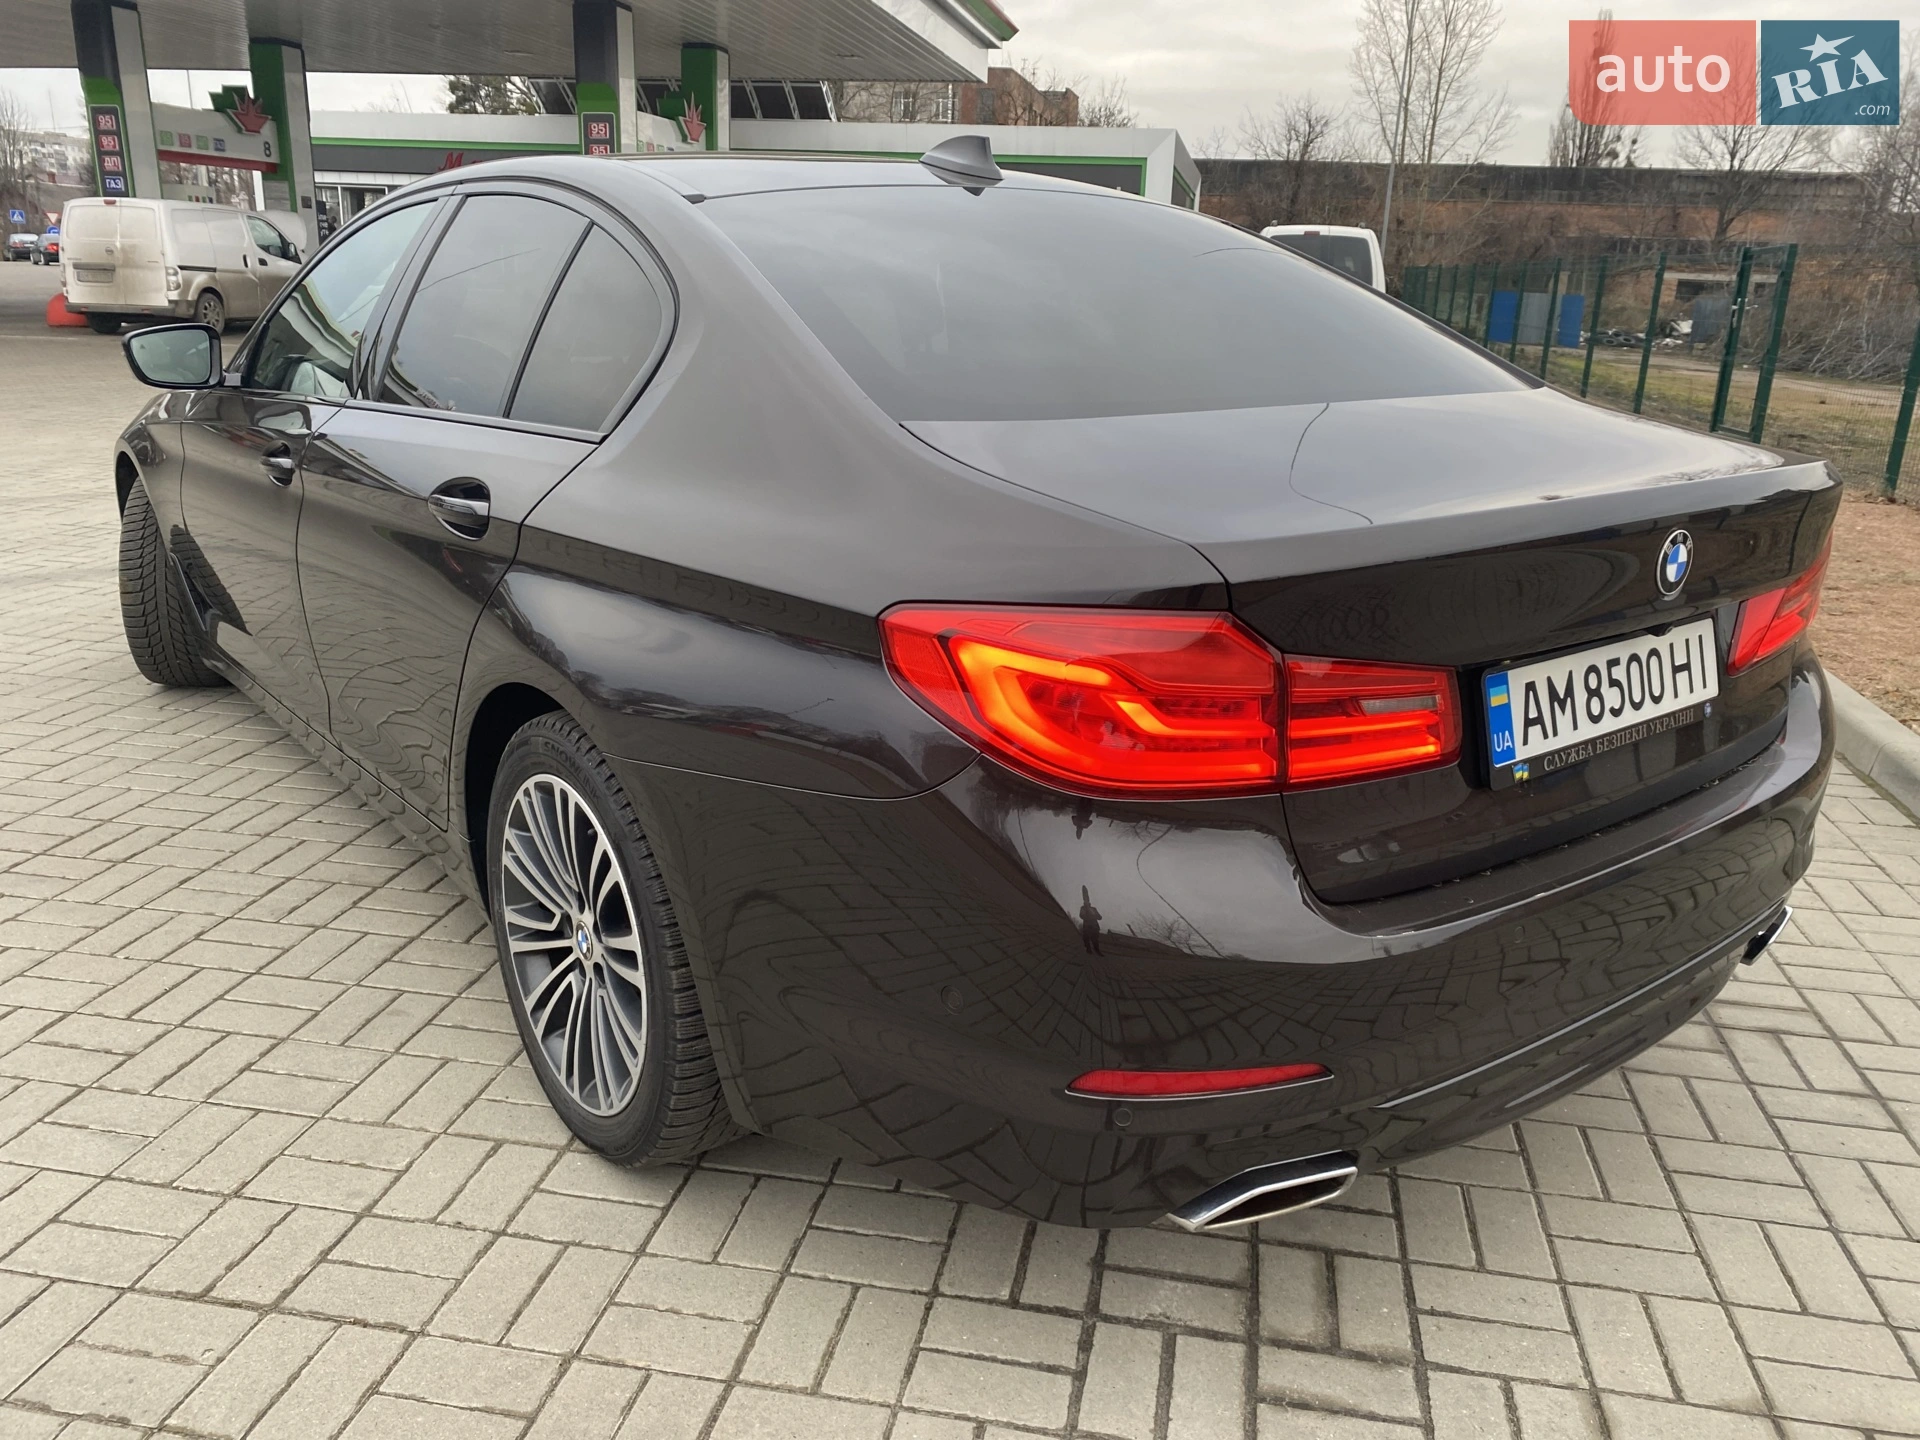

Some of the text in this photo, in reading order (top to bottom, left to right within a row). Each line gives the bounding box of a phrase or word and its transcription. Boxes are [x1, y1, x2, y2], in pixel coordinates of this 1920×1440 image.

[98, 115, 112, 126] 95
[591, 123, 606, 134] 95
[101, 136, 114, 146] 95
[263, 141, 272, 158] 8
[105, 179, 121, 189] ГАЗ
[1494, 731, 1513, 752] UA
[1543, 745, 1594, 771] СЛУЖБА
[1596, 726, 1647, 754] БЕЗПЕКИ
